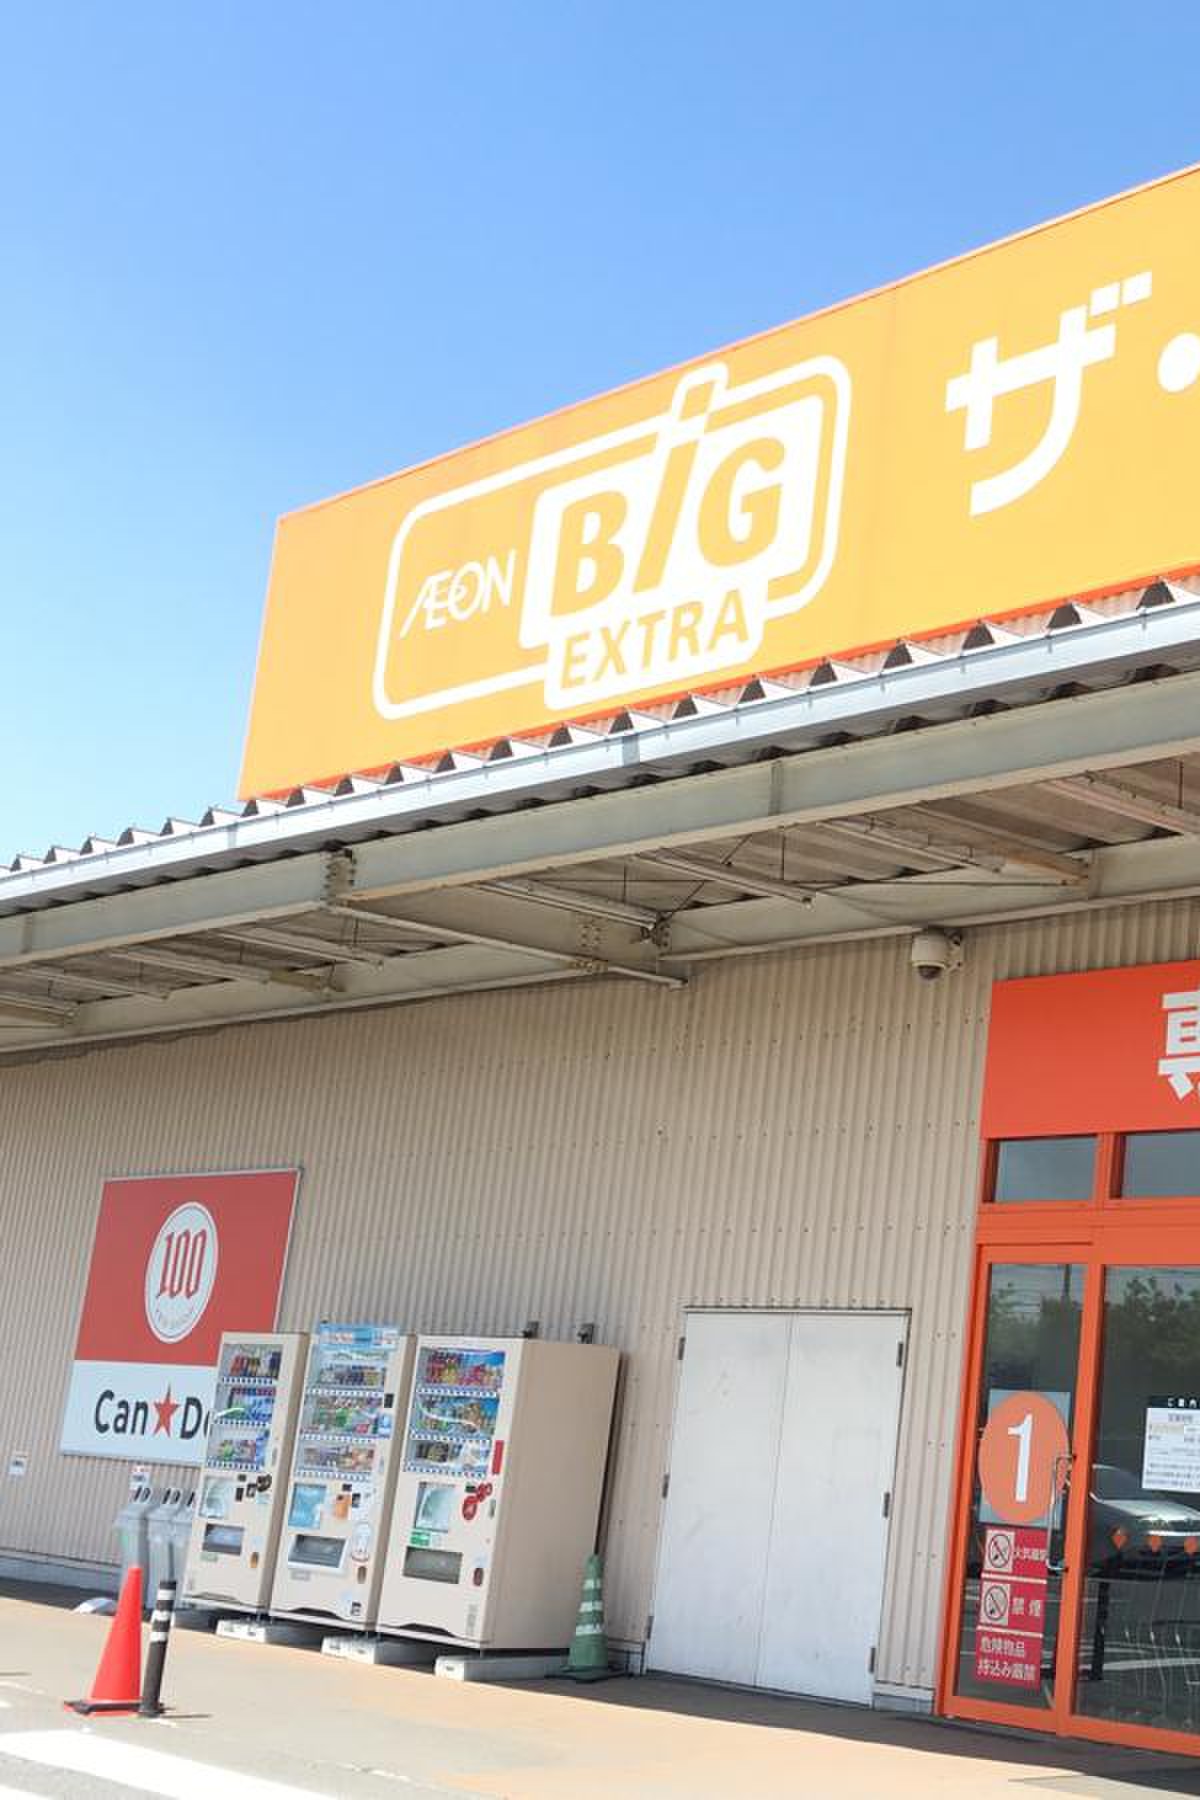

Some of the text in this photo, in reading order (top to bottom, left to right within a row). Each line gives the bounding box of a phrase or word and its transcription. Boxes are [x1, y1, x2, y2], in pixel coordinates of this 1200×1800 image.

[560, 587, 751, 690] EXTRA
[155, 1228, 207, 1299] 100
[1007, 1412, 1033, 1502] 1
